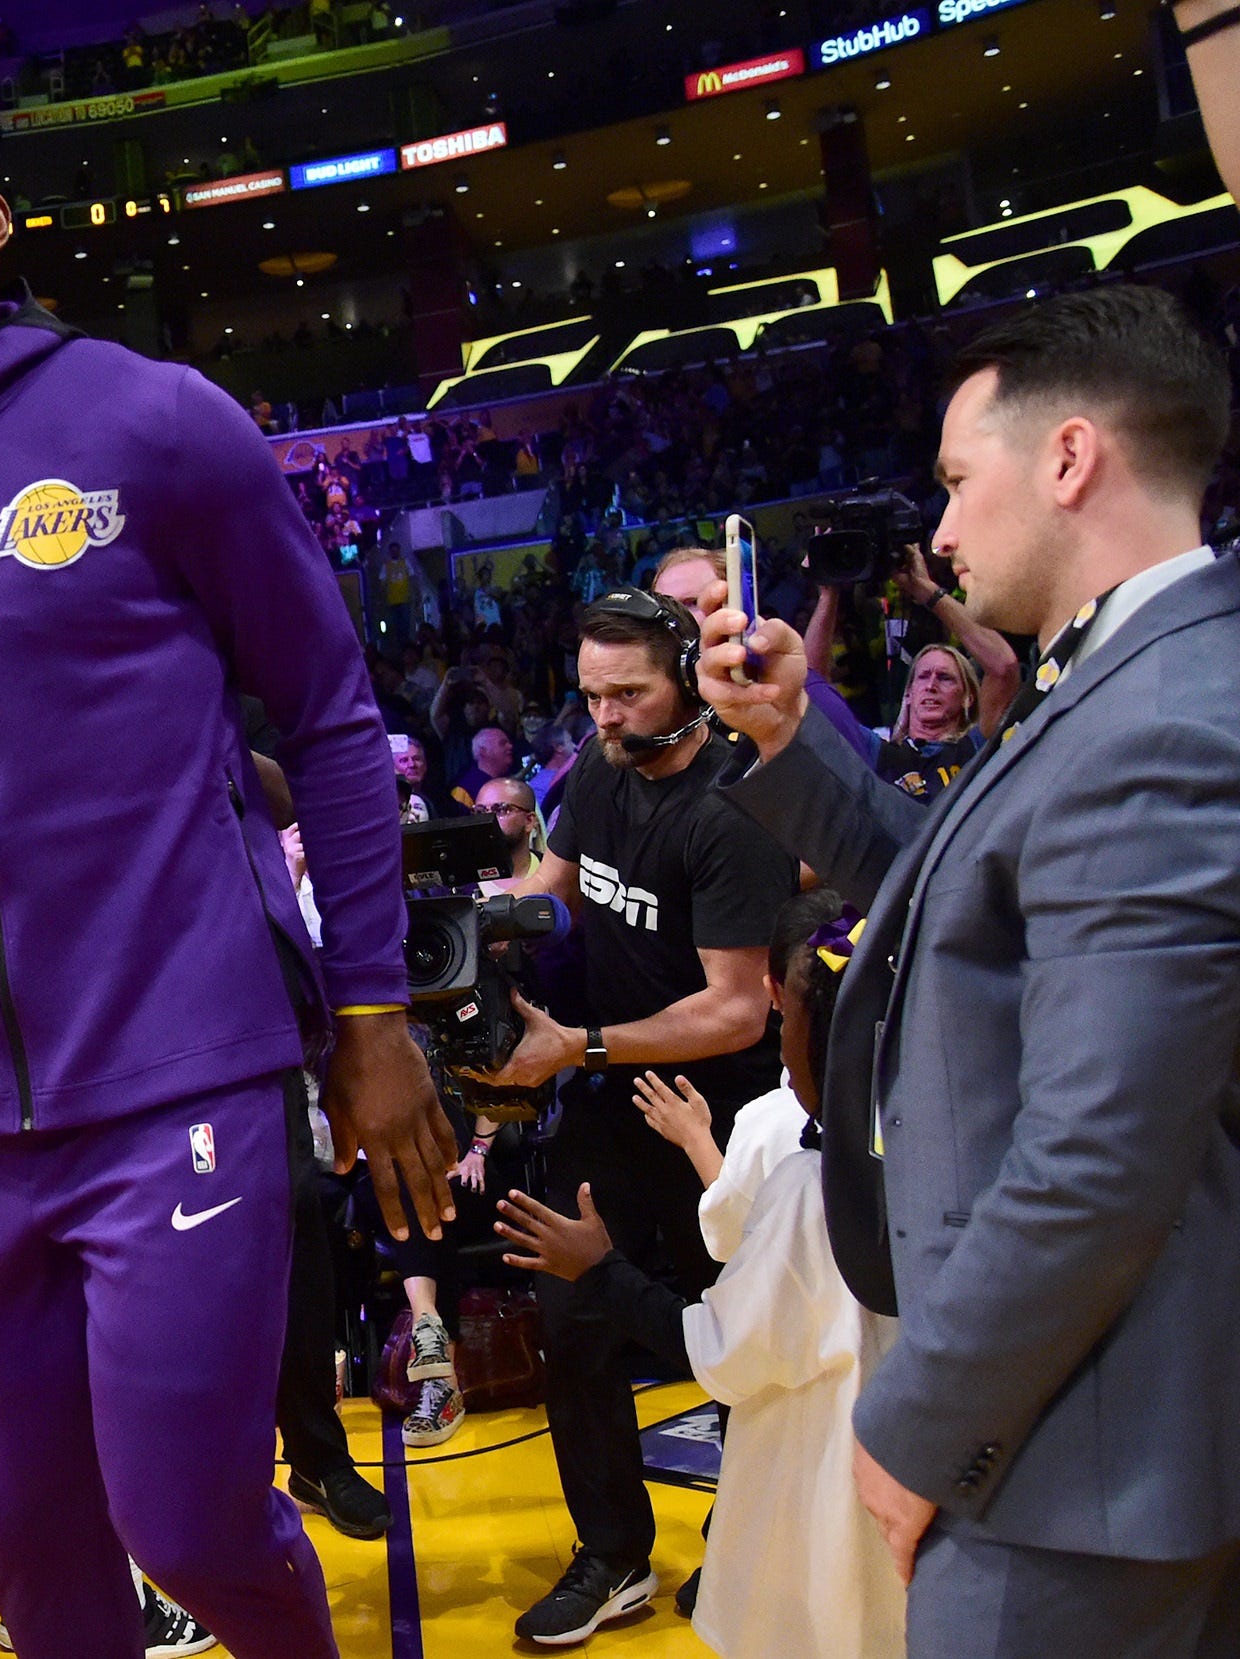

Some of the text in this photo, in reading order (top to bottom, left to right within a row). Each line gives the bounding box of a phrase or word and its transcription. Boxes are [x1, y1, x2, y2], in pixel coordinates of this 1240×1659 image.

[821, 15, 920, 64] StubHub
[88, 97, 135, 119] 69050
[402, 126, 505, 165] TOSHIBA
[306, 157, 381, 181] BUD LIGHT
[90, 203, 105, 225] 0
[28, 494, 113, 512] LOS ANGELES
[579, 853, 658, 931] ESPN
